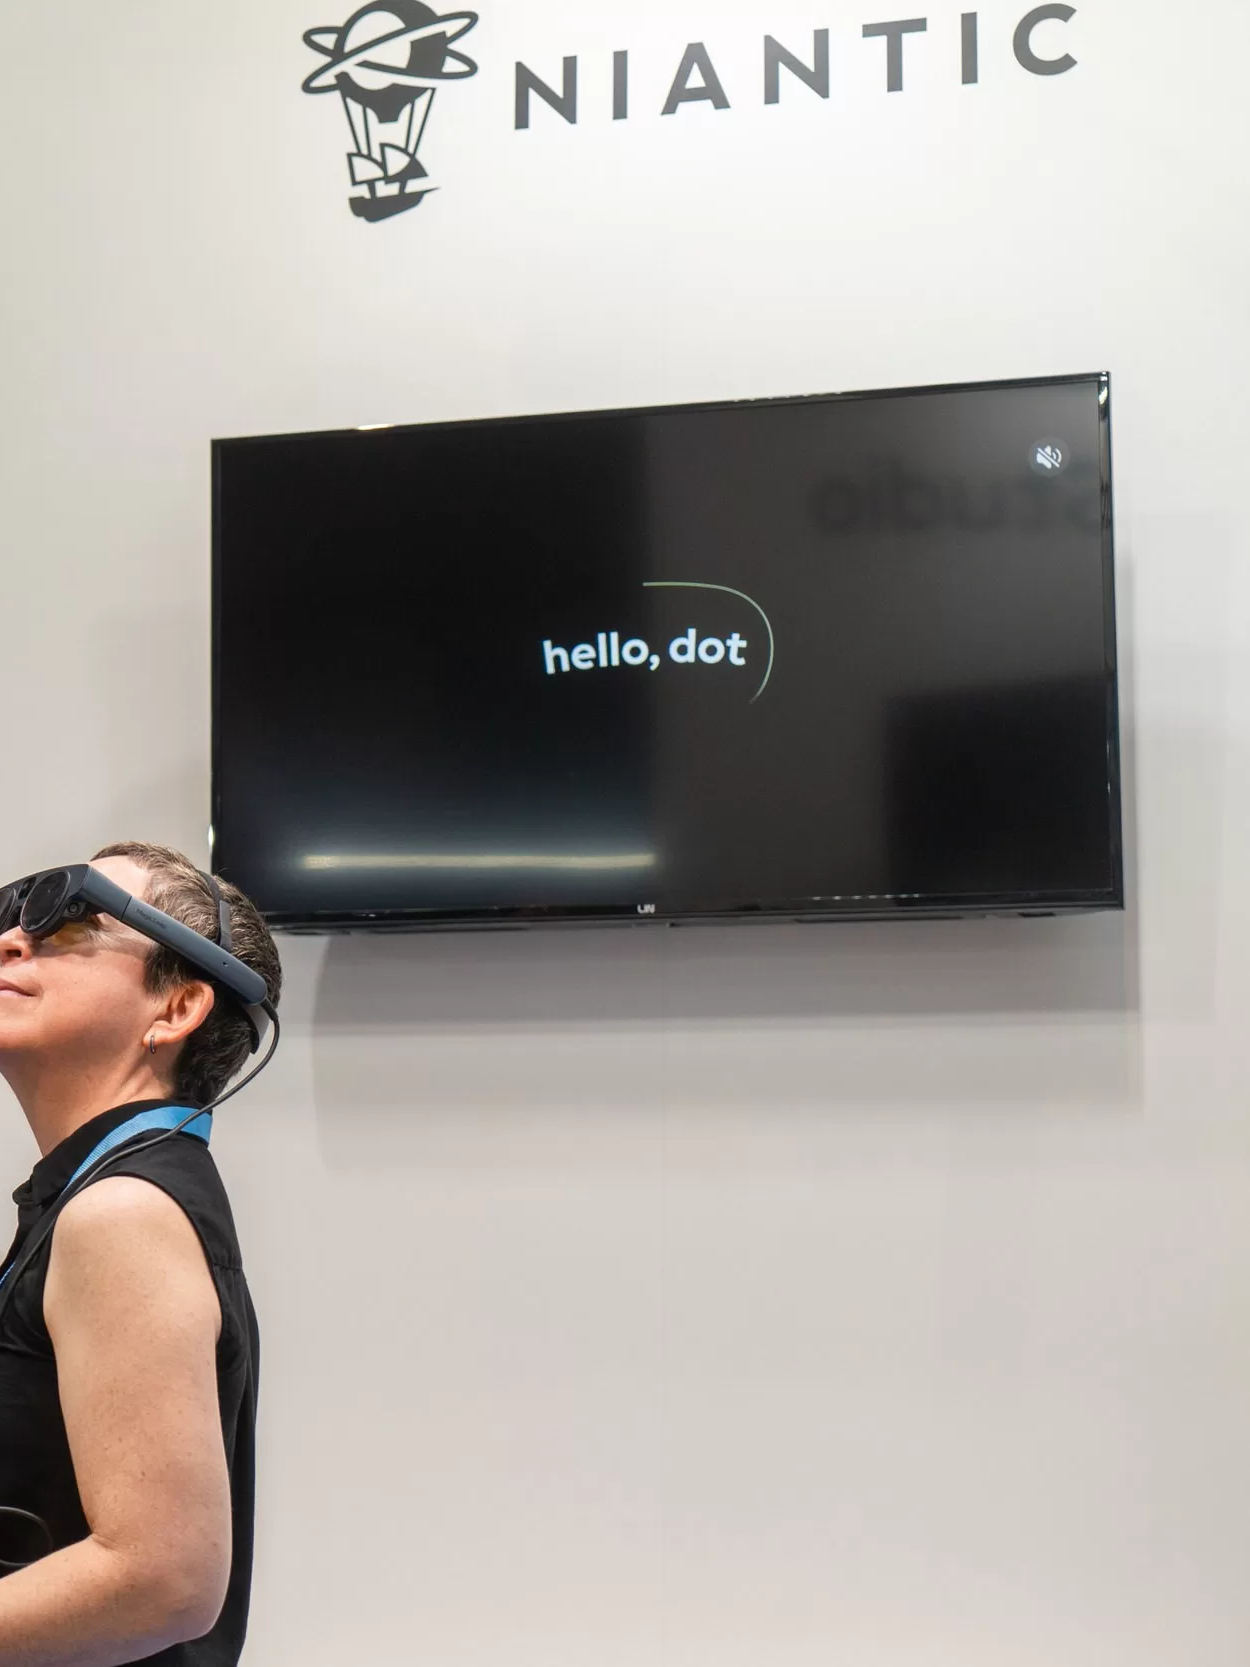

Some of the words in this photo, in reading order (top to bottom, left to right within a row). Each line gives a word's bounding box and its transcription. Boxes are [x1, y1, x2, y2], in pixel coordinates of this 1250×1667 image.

[514, 2, 1078, 131] NIANTIC
[542, 630, 661, 675] hello,
[668, 627, 748, 666] dot
